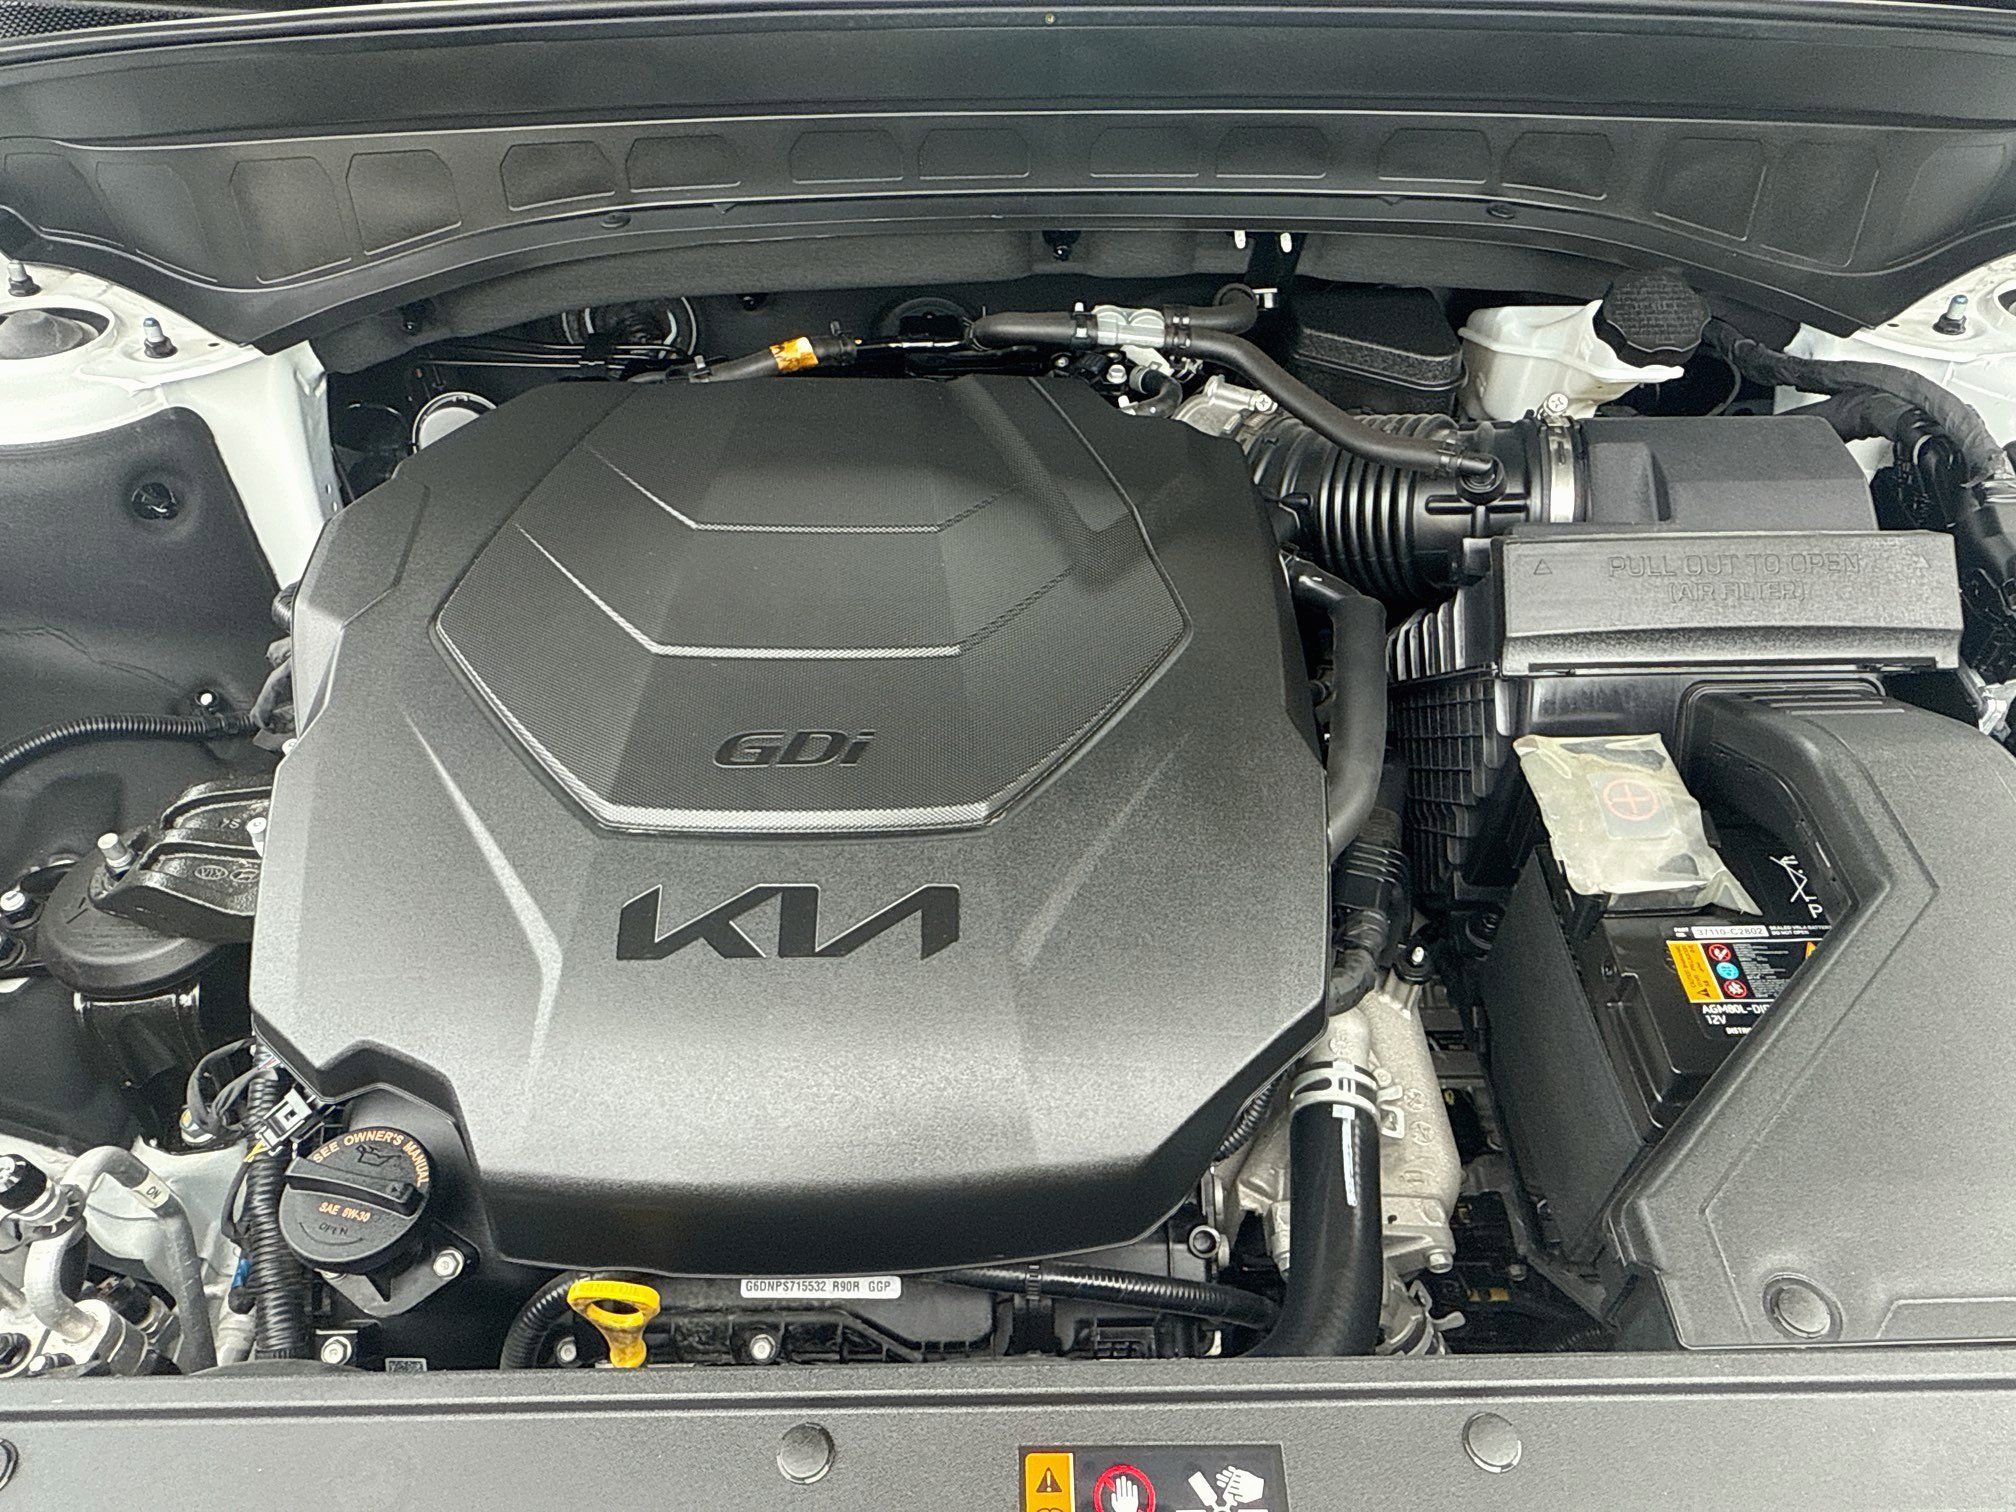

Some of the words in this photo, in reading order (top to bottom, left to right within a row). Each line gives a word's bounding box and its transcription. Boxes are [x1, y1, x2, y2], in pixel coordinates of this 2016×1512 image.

[1607, 555, 1677, 577] PULL
[1684, 554, 1739, 576] OUT
[1748, 553, 1781, 575] TO
[1789, 552, 1861, 575] OPEN
[1669, 581, 1716, 604] (AIR
[1722, 580, 1806, 602] FILTER)
[713, 729, 876, 768] GDi
[616, 883, 960, 960] KIA
[1696, 927, 1764, 936] 37110-C2802
[1705, 1014, 1727, 1025] 12V
[313, 1142, 340, 1163] SEE
[344, 1130, 404, 1146] OWNER'S
[403, 1140, 430, 1187] MANUAL
[318, 1201, 341, 1216] SAE
[318, 1222, 349, 1235] OPEN
[745, 1280, 827, 1293] G6DNPS715532
[868, 1280, 891, 1292] GGP
